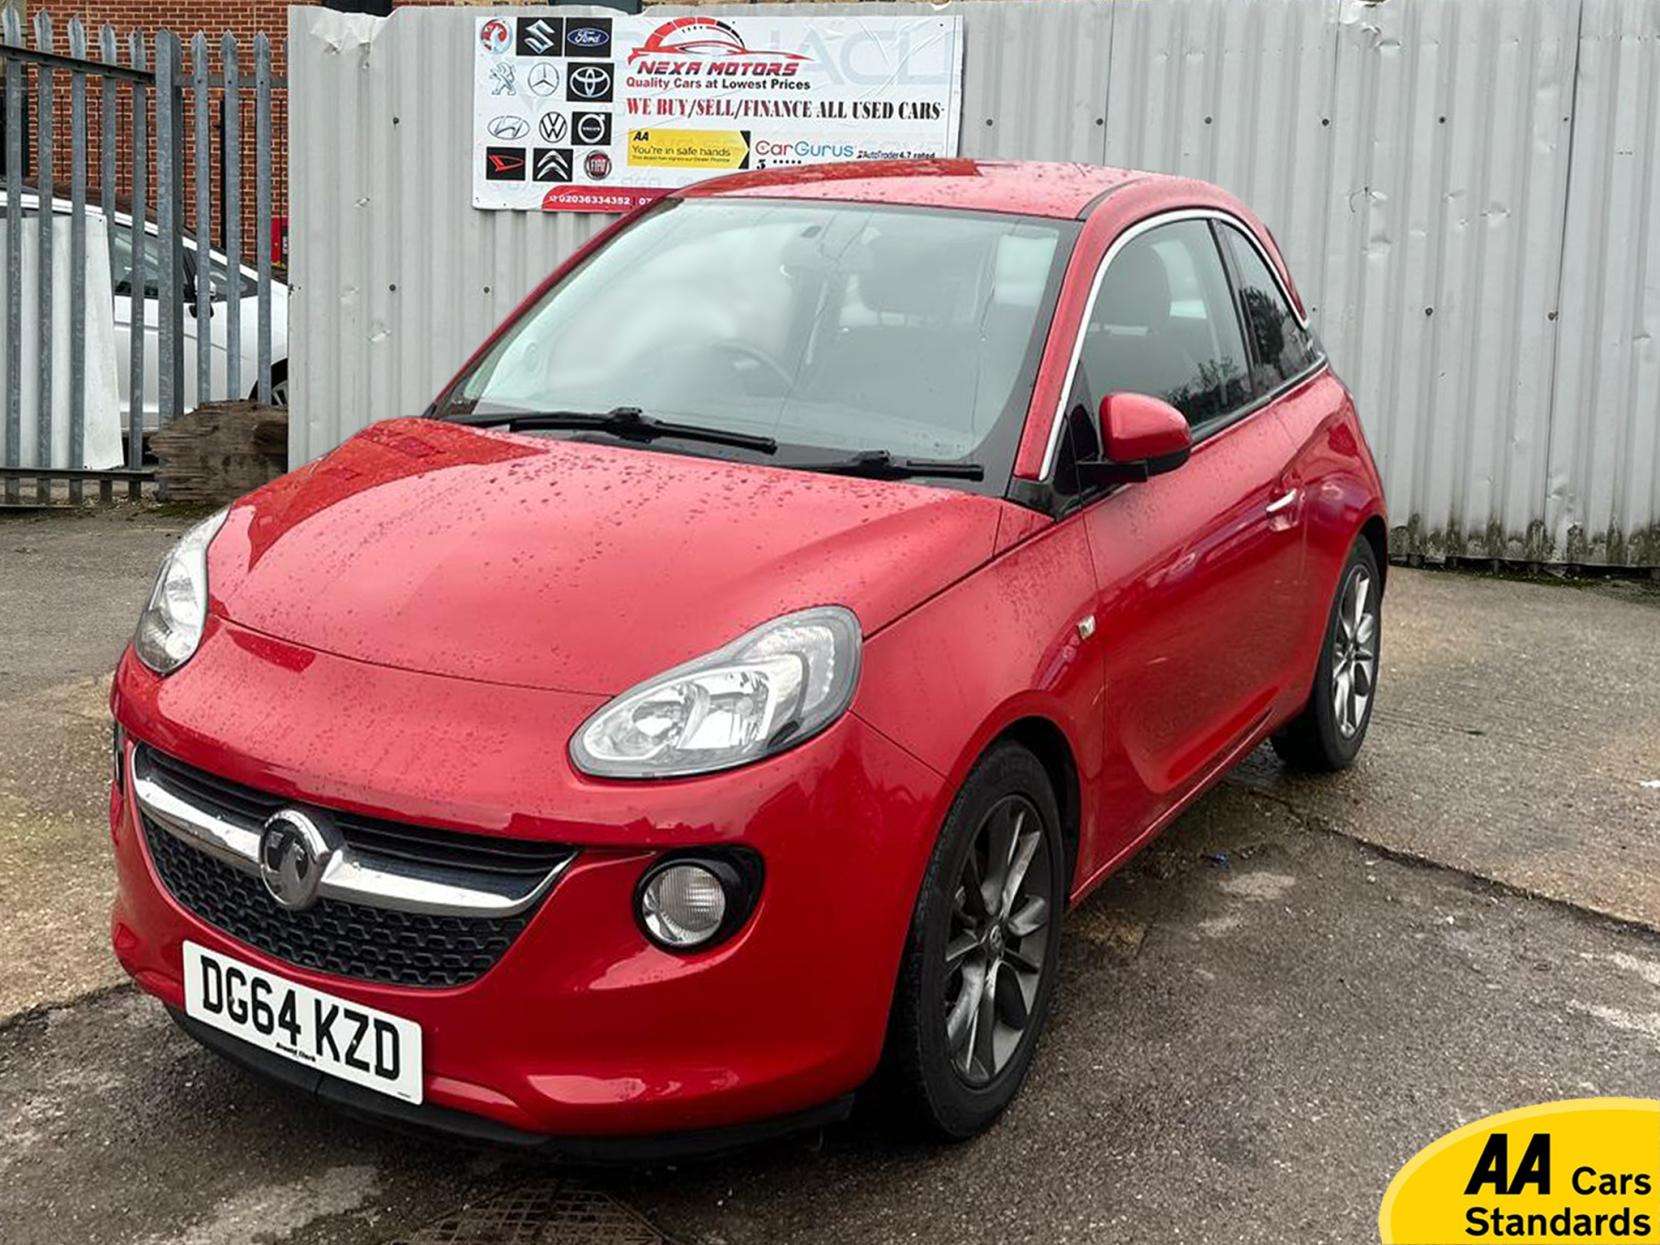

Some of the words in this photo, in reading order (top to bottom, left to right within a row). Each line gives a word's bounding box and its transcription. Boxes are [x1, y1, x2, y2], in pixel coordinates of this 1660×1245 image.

[637, 61, 702, 76] NEXA
[706, 62, 799, 77] MOTORS
[626, 77, 670, 90] Quality
[674, 78, 701, 89] Cars
[705, 79, 718, 89] at
[722, 79, 767, 89] Lowest
[771, 79, 811, 90] Prices
[626, 98, 651, 115] WE
[656, 98, 812, 119] BUY/SELL/FINANCE
[817, 101, 847, 118] ALL
[852, 101, 894, 119] USED
[633, 131, 650, 141] AA
[631, 145, 663, 155] You're
[665, 147, 674, 155] in
[677, 146, 698, 156] safe
[700, 147, 731, 157] hands
[755, 140, 854, 158] CarGurus
[201, 954, 301, 1047] DG64
[315, 997, 400, 1081] KZD
